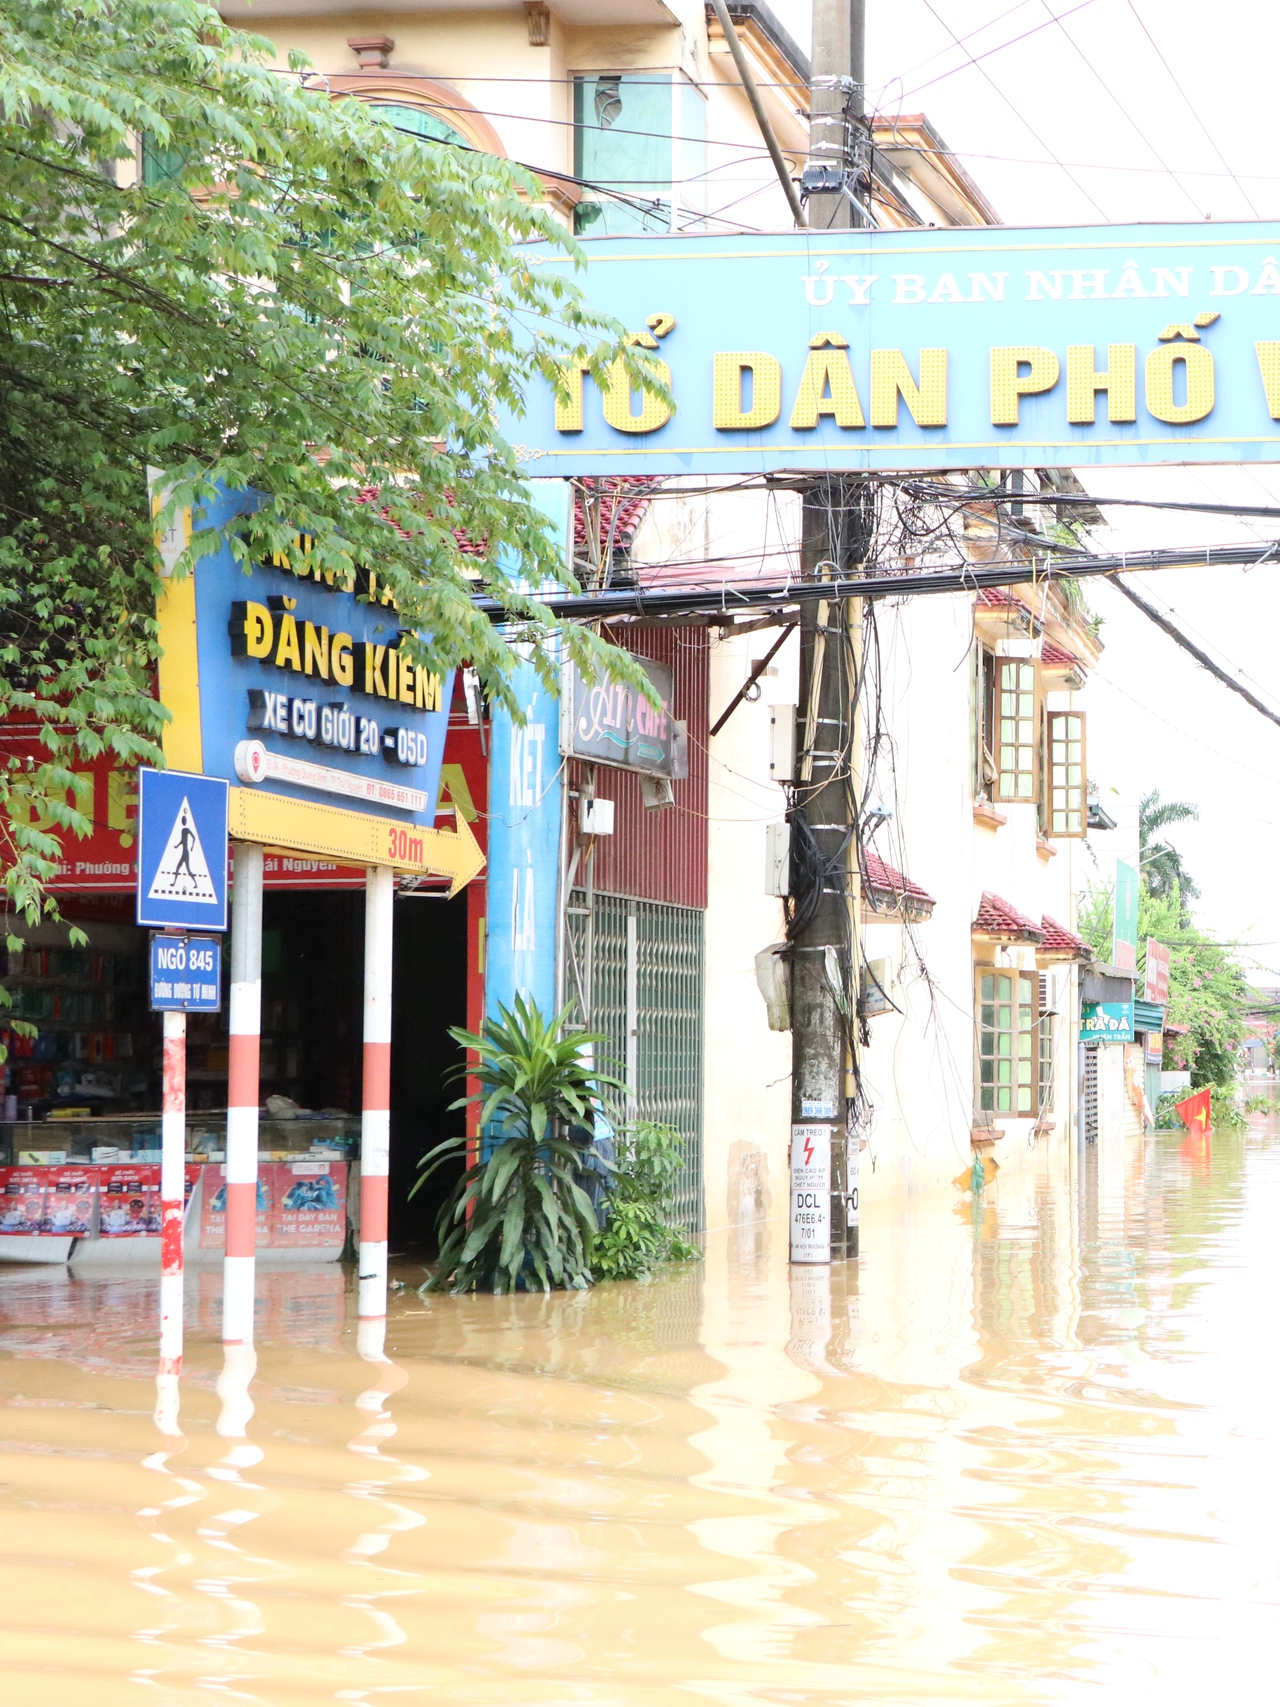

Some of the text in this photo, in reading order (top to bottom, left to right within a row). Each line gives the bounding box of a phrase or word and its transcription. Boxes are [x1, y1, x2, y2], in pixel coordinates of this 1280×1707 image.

[802, 259, 879, 305] ỦY
[891, 272, 1009, 304] BAN
[1025, 260, 1199, 301] NHÂN
[554, 312, 677, 434] TỔ
[712, 331, 949, 431] DÂN
[988, 311, 1222, 426] PHỐ
[243, 595, 354, 687] ĐĂNG
[264, 691, 289, 734] XE
[291, 697, 317, 740] CƠ
[321, 703, 356, 751] GIỚI
[359, 717, 380, 756] 20
[397, 729, 428, 767] 05D
[509, 691, 546, 808] KẾT
[379, 786, 395, 801] 0865
[397, 790, 408, 803] 651
[411, 792, 422, 807] 111
[388, 827, 424, 864] 30m
[76, 861, 130, 876] Phường
[511, 848, 536, 952] LÀ
[158, 943, 213, 971] NGÕ 845
[1109, 1016, 1130, 1031] ĐÁ
[797, 1193, 821, 1209] DCL
[800, 1227, 816, 1239] 7/01
